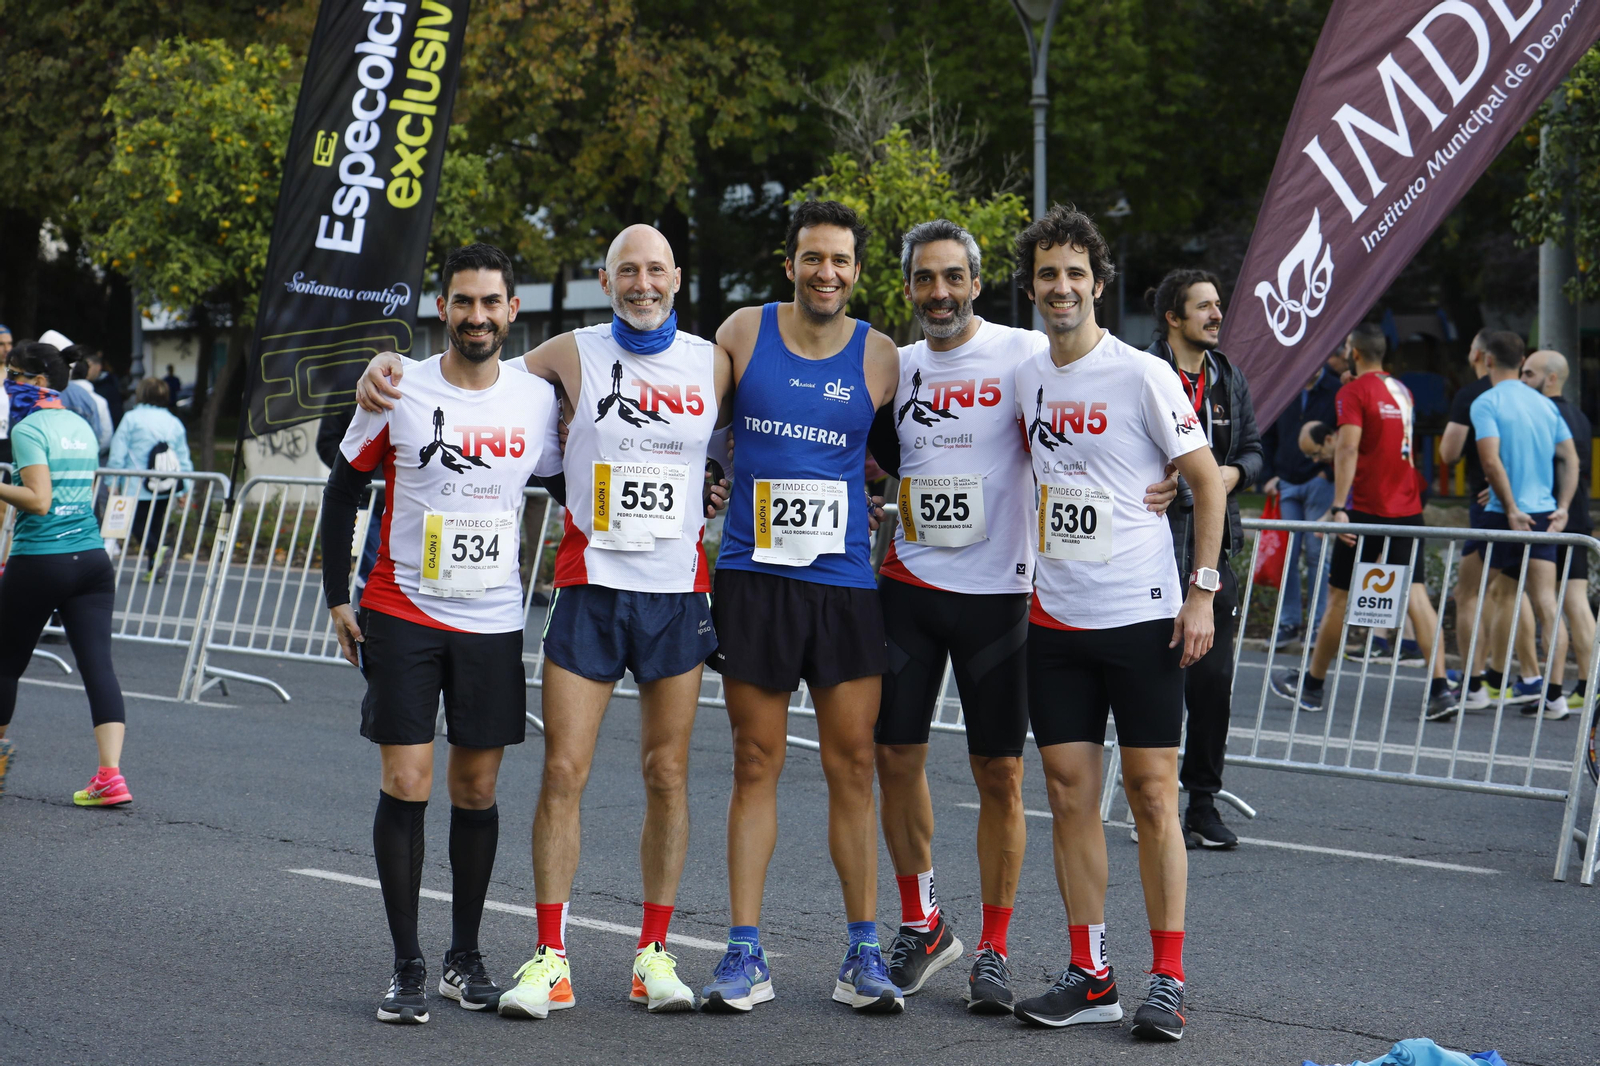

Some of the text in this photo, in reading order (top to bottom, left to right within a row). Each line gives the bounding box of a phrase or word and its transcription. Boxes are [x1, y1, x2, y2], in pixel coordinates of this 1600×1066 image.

[1360, 176, 1426, 253] Instituto
[1426, 85, 1508, 180] Municipal
[1504, 63, 1532, 90] de
[285, 271, 411, 316] Soñamos contigo
[744, 416, 847, 447] TROTASIERRA
[914, 434, 973, 449] El Candil
[619, 438, 684, 451] El Candil
[623, 465, 660, 475] IMDECO
[441, 482, 501, 496] El Candil
[782, 482, 819, 492] IMDECO
[918, 478, 951, 487] IMDECO
[1053, 486, 1082, 497] IMDECO
[621, 481, 674, 512] 553
[772, 498, 839, 528] 2371
[920, 493, 970, 522] 525
[455, 518, 493, 528] IMDECO
[1050, 503, 1097, 534] 530
[428, 541, 437, 569] CAJÓN
[451, 534, 500, 562] 534
[1357, 596, 1393, 609] esm
